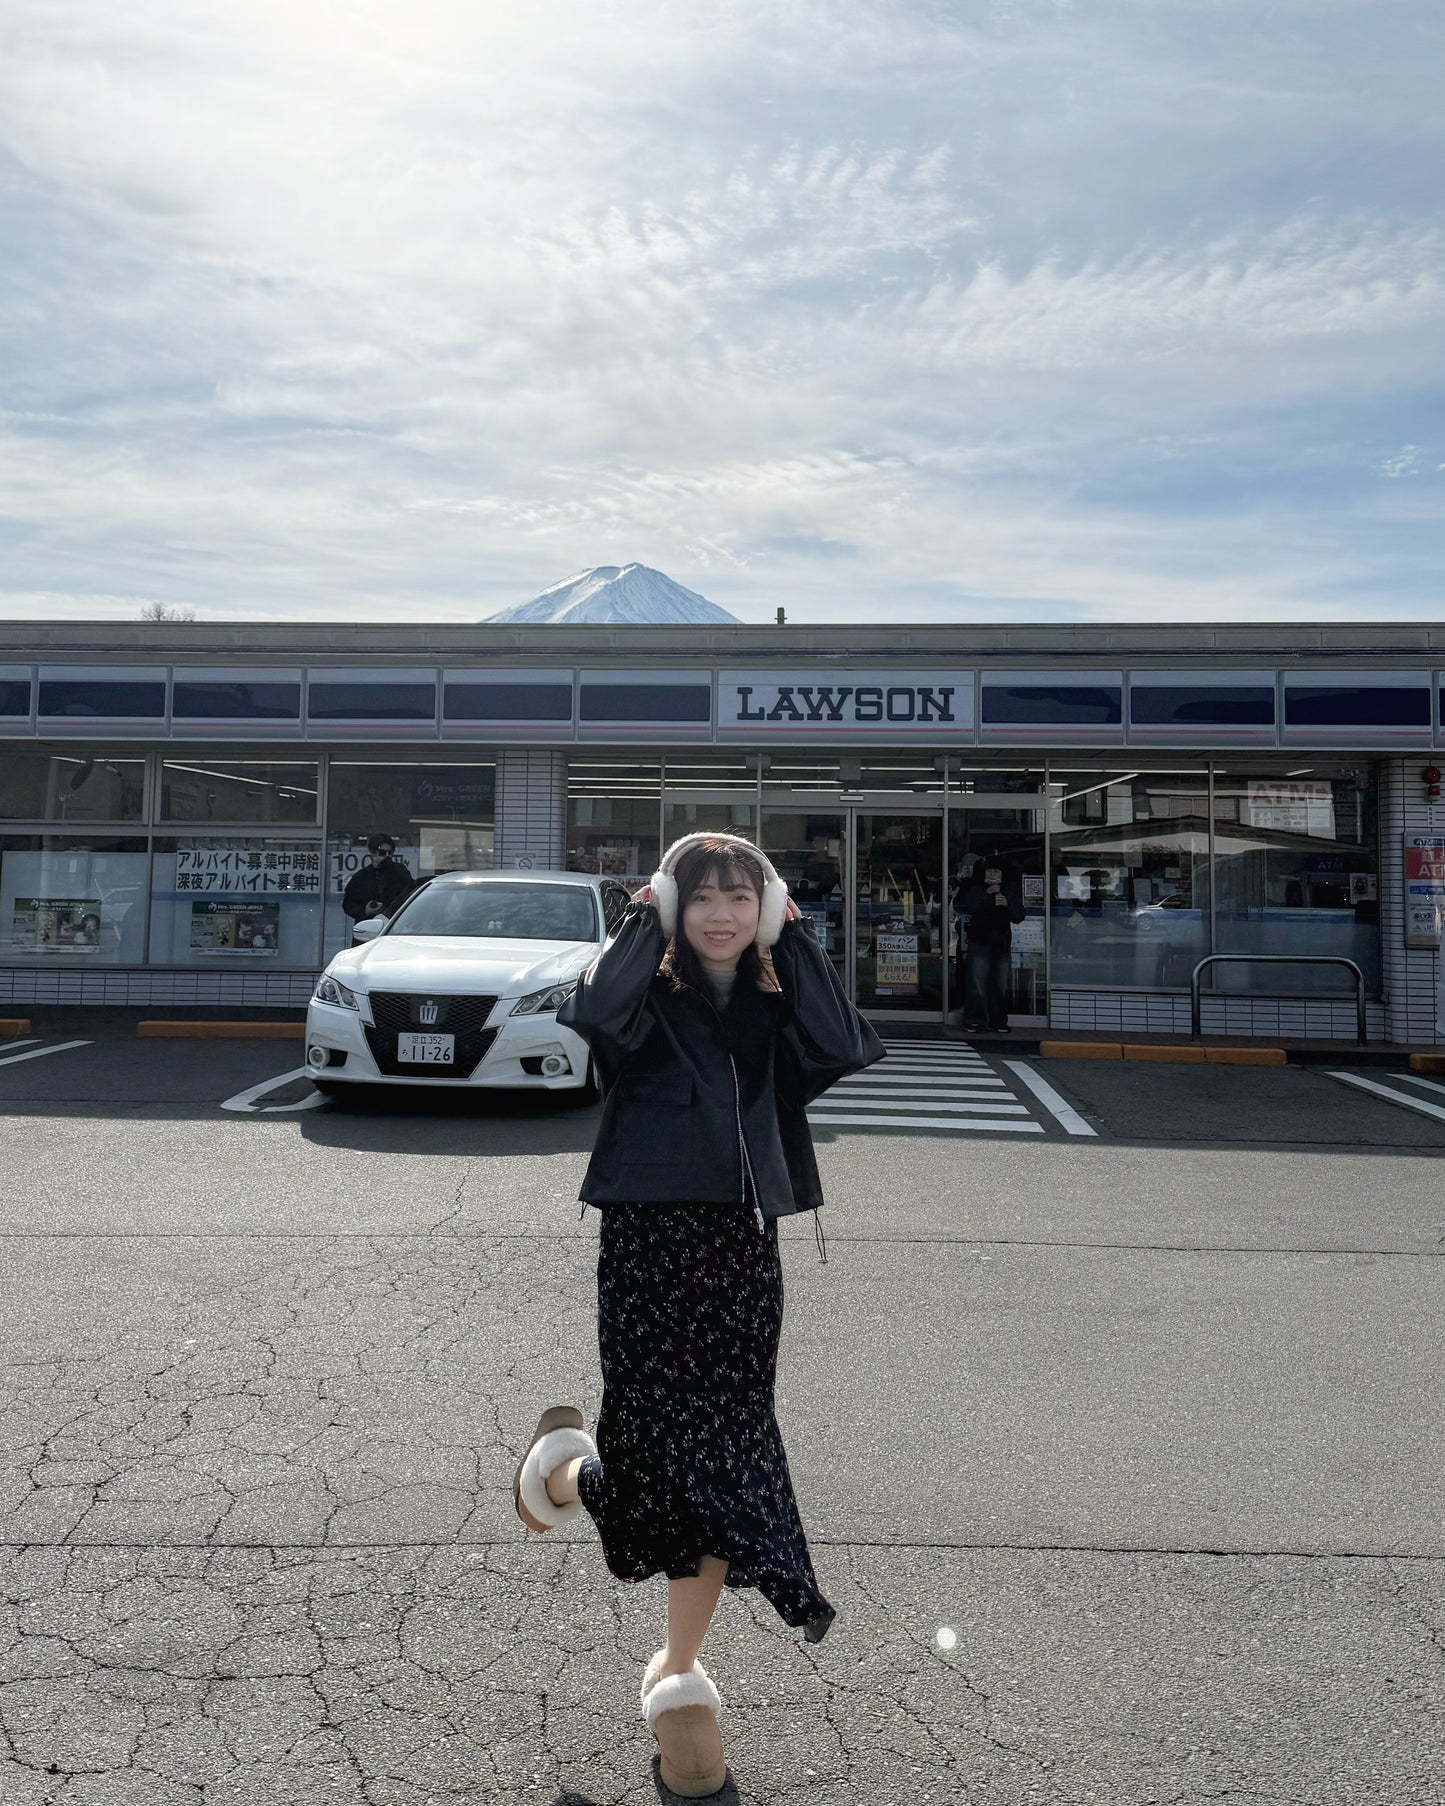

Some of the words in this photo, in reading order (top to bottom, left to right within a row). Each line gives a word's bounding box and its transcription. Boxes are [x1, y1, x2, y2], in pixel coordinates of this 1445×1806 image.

[737, 687, 955, 721] LAWSON
[1252, 784, 1313, 804] ATM
[178, 851, 319, 871] アルバイト募集中時給
[178, 872, 319, 891] 深夜アルバイト募集中
[412, 1045, 451, 1061] 11-26
